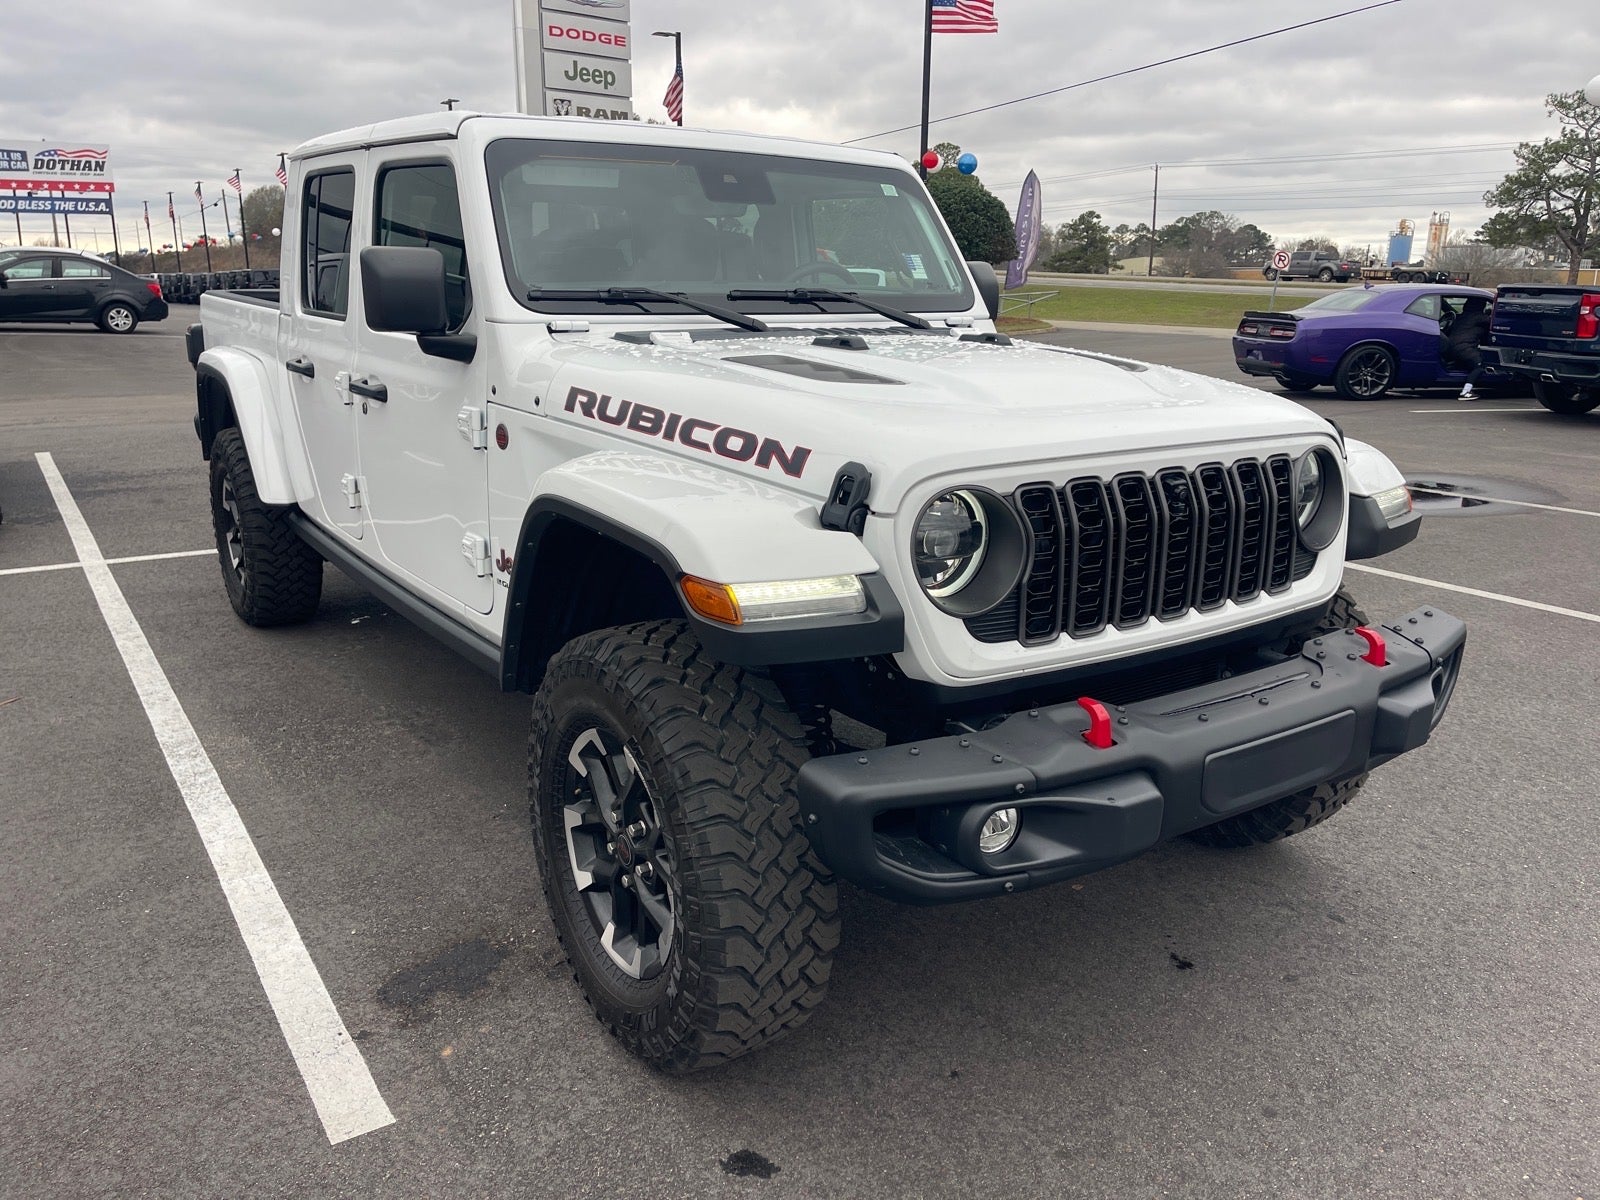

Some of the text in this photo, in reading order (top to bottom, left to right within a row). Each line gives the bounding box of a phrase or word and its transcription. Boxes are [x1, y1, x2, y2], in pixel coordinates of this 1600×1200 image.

[548, 25, 626, 47] DODGE
[564, 60, 616, 89] Jeep
[576, 106, 629, 120] RAM
[10, 152, 22, 161] US
[10, 161, 28, 170] CAR
[33, 158, 106, 172] DOTHAN
[17, 200, 52, 210] BLESS
[54, 201, 75, 211] THE
[77, 201, 110, 212] U.S.A.
[1016, 187, 1033, 271] CHRYSLER
[563, 385, 813, 479] RUBICON
[496, 549, 513, 575] Je
